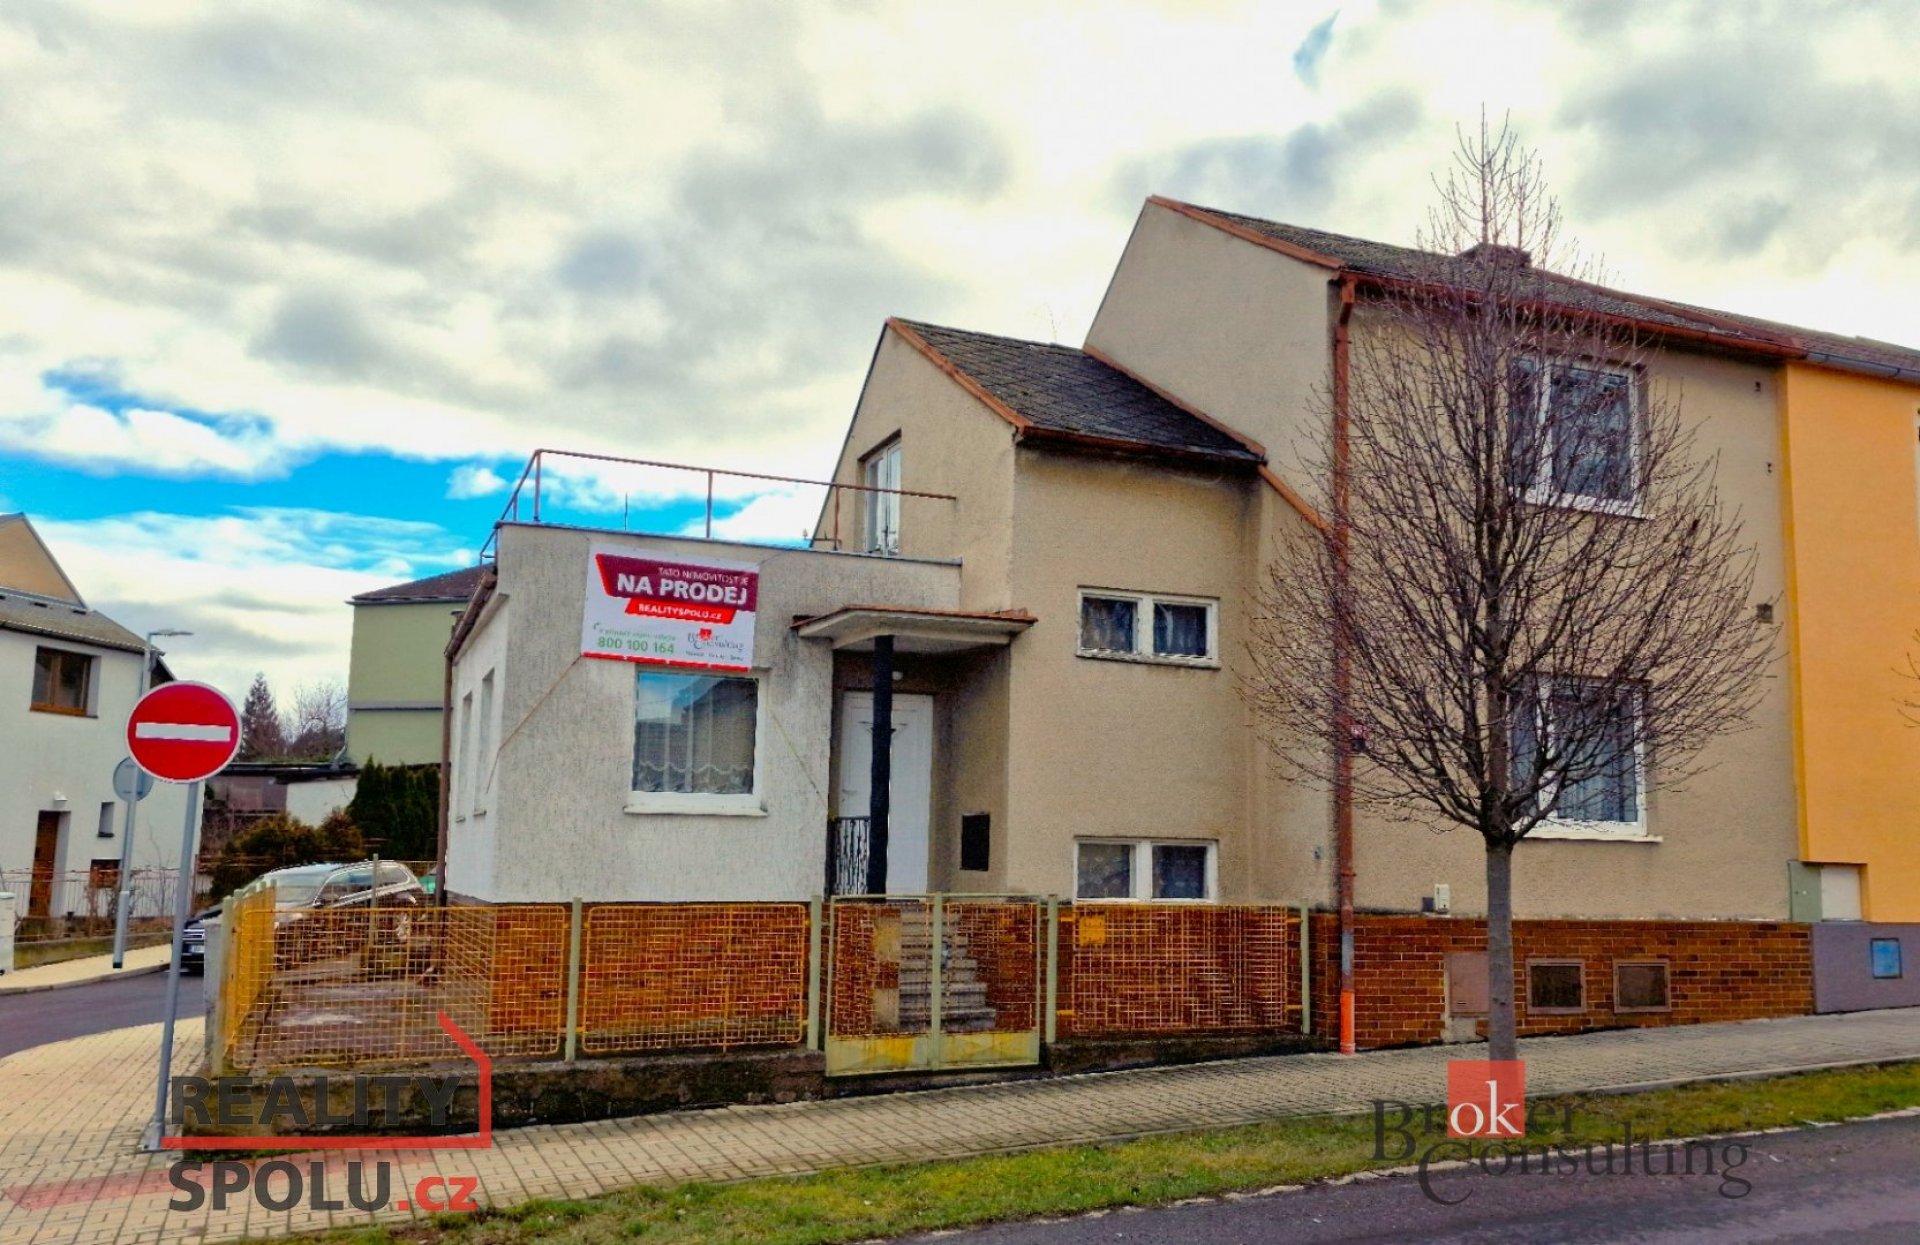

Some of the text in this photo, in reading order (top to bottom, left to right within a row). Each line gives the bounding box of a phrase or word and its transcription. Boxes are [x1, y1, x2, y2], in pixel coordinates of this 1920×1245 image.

[658, 566, 680, 578] TATO
[617, 572, 748, 606] NA PRODEJ
[597, 636, 675, 655] 800 100 164
